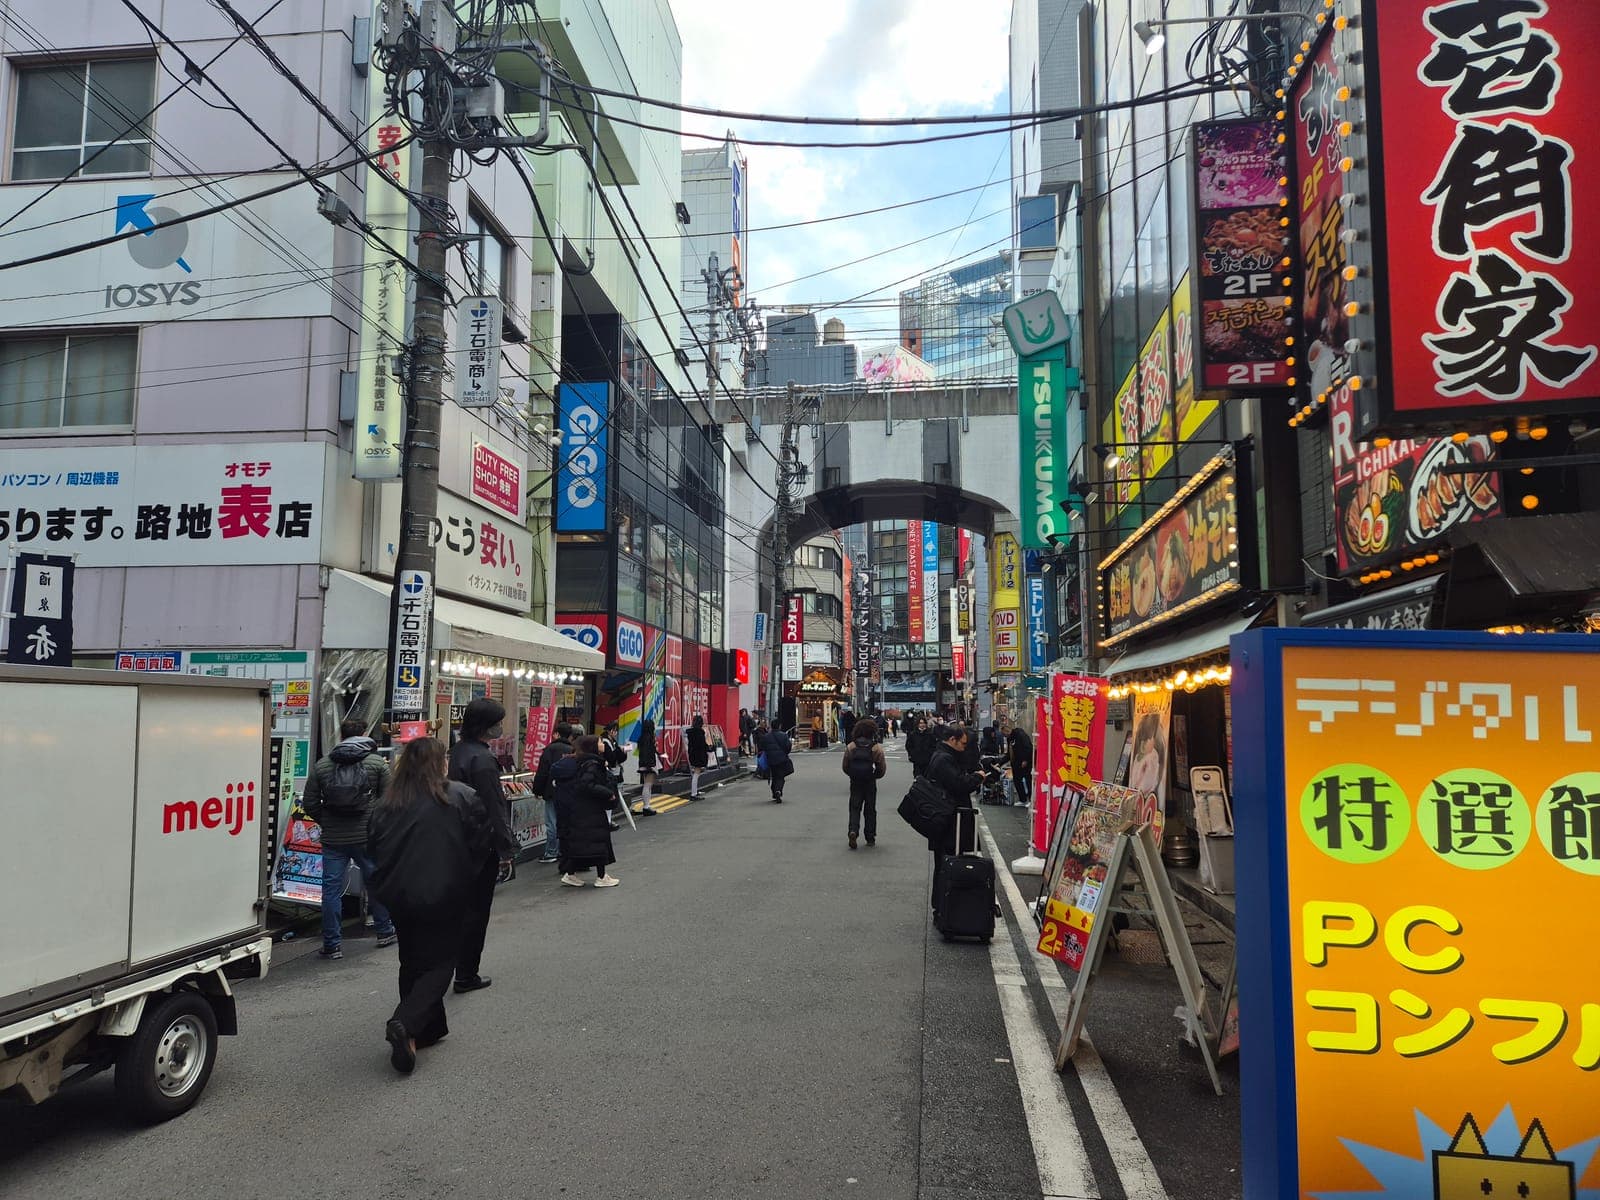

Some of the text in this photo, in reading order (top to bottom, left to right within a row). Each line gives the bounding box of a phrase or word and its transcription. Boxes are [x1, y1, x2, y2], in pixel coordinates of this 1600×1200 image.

[1303, 156, 1324, 212] 2F
[104, 280, 202, 309] IOSYS
[1223, 273, 1272, 295] 2F
[468, 319, 487, 378] 千石電商
[1227, 363, 1276, 385] 2F
[364, 447, 391, 455] IOSYS
[1033, 361, 1055, 545] TSUKUMO
[225, 462, 272, 478] オモテ
[475, 447, 518, 484] DUTY FREE
[475, 465, 498, 487] SHOP
[1, 473, 51, 487] パソコン
[66, 472, 119, 486] 周辺機器
[468, 574, 491, 592] イオシス
[959, 585, 968, 611] DVD
[400, 598, 421, 664] 千石電商
[787, 614, 797, 641] KFC
[119, 655, 176, 671] 高価買取
[162, 781, 255, 836] meiji
[1040, 922, 1062, 955] 2F
[1303, 901, 1463, 974] PC
